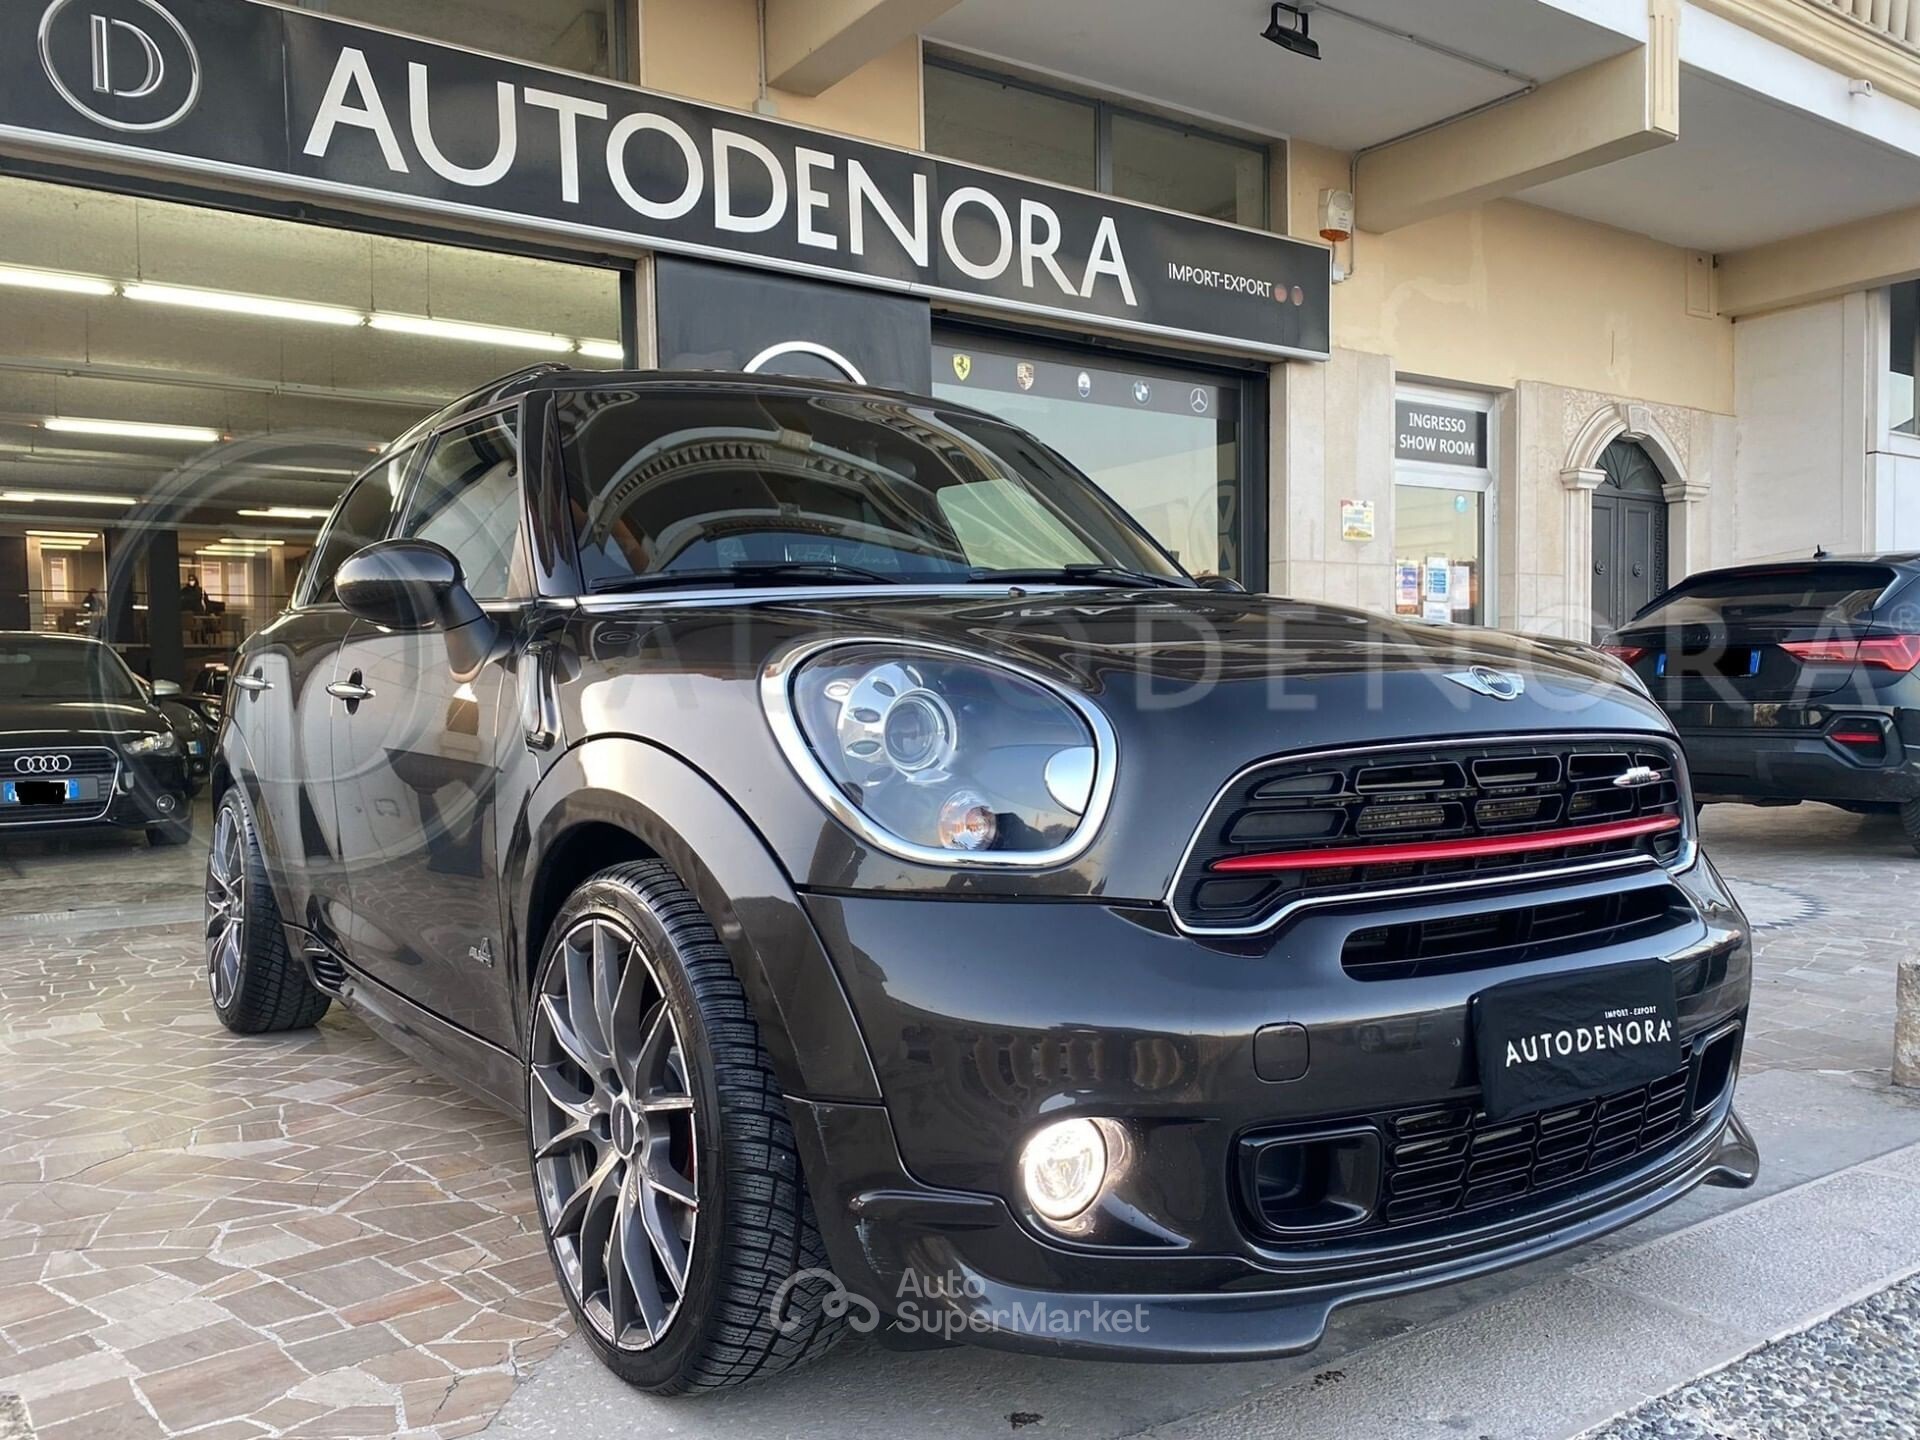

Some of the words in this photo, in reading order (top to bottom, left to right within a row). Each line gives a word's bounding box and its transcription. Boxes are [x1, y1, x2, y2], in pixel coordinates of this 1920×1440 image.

[302, 47, 1138, 306] AUTODENORA
[1168, 262, 1272, 298] IMPORT-EXPORT
[1408, 412, 1466, 433] INGRESSO
[1399, 434, 1437, 452] SHOW
[1439, 438, 1475, 456] ROOM
[1604, 1008, 1629, 1019] IMPORT
[1633, 1005, 1657, 1016] EXPORT
